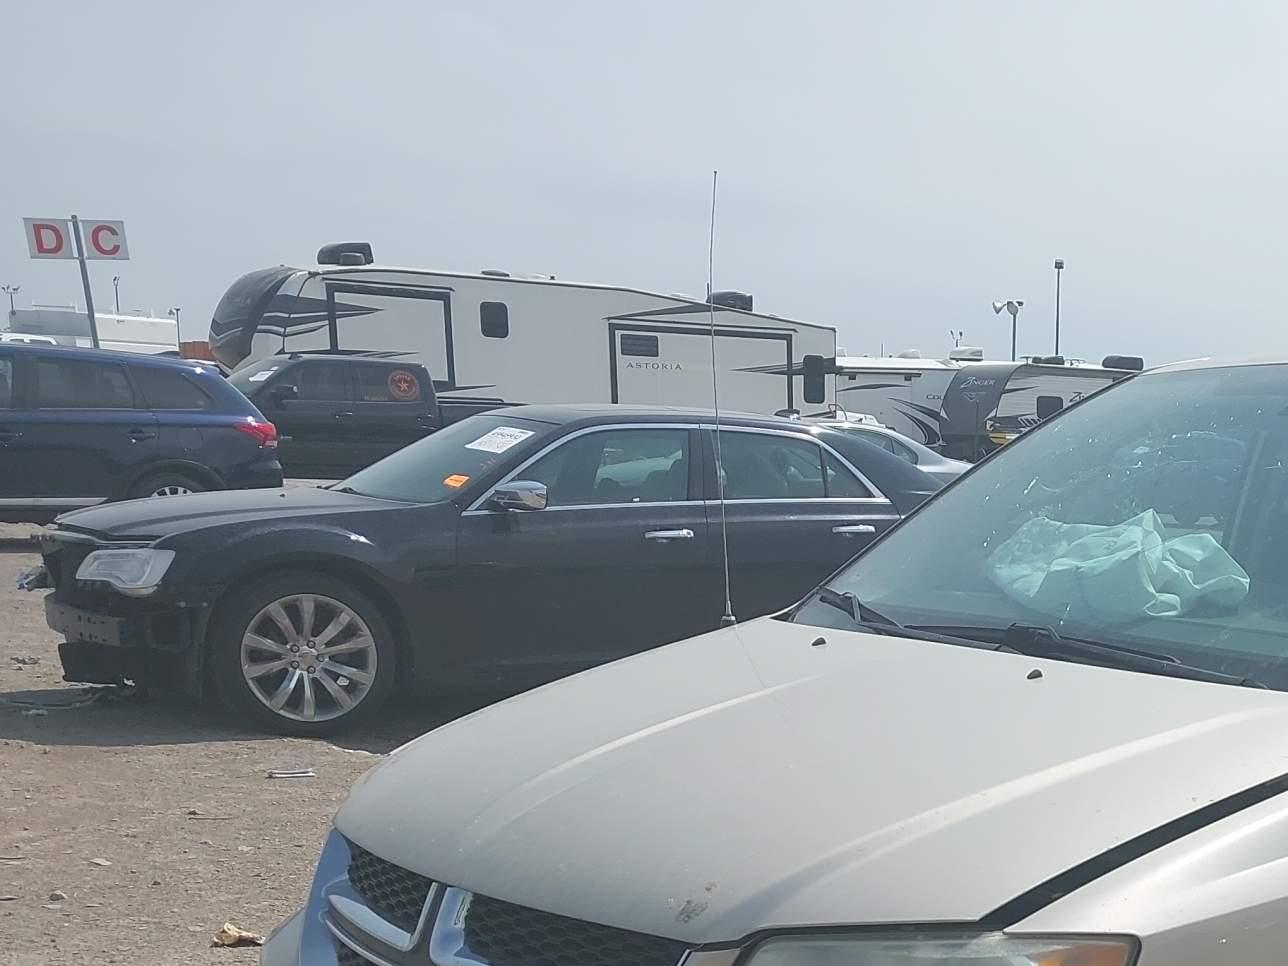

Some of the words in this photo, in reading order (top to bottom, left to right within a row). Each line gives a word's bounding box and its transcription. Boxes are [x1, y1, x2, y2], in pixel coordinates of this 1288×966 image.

[32, 223, 64, 254] D
[91, 224, 121, 256] C
[626, 362, 682, 370] ASTORIA
